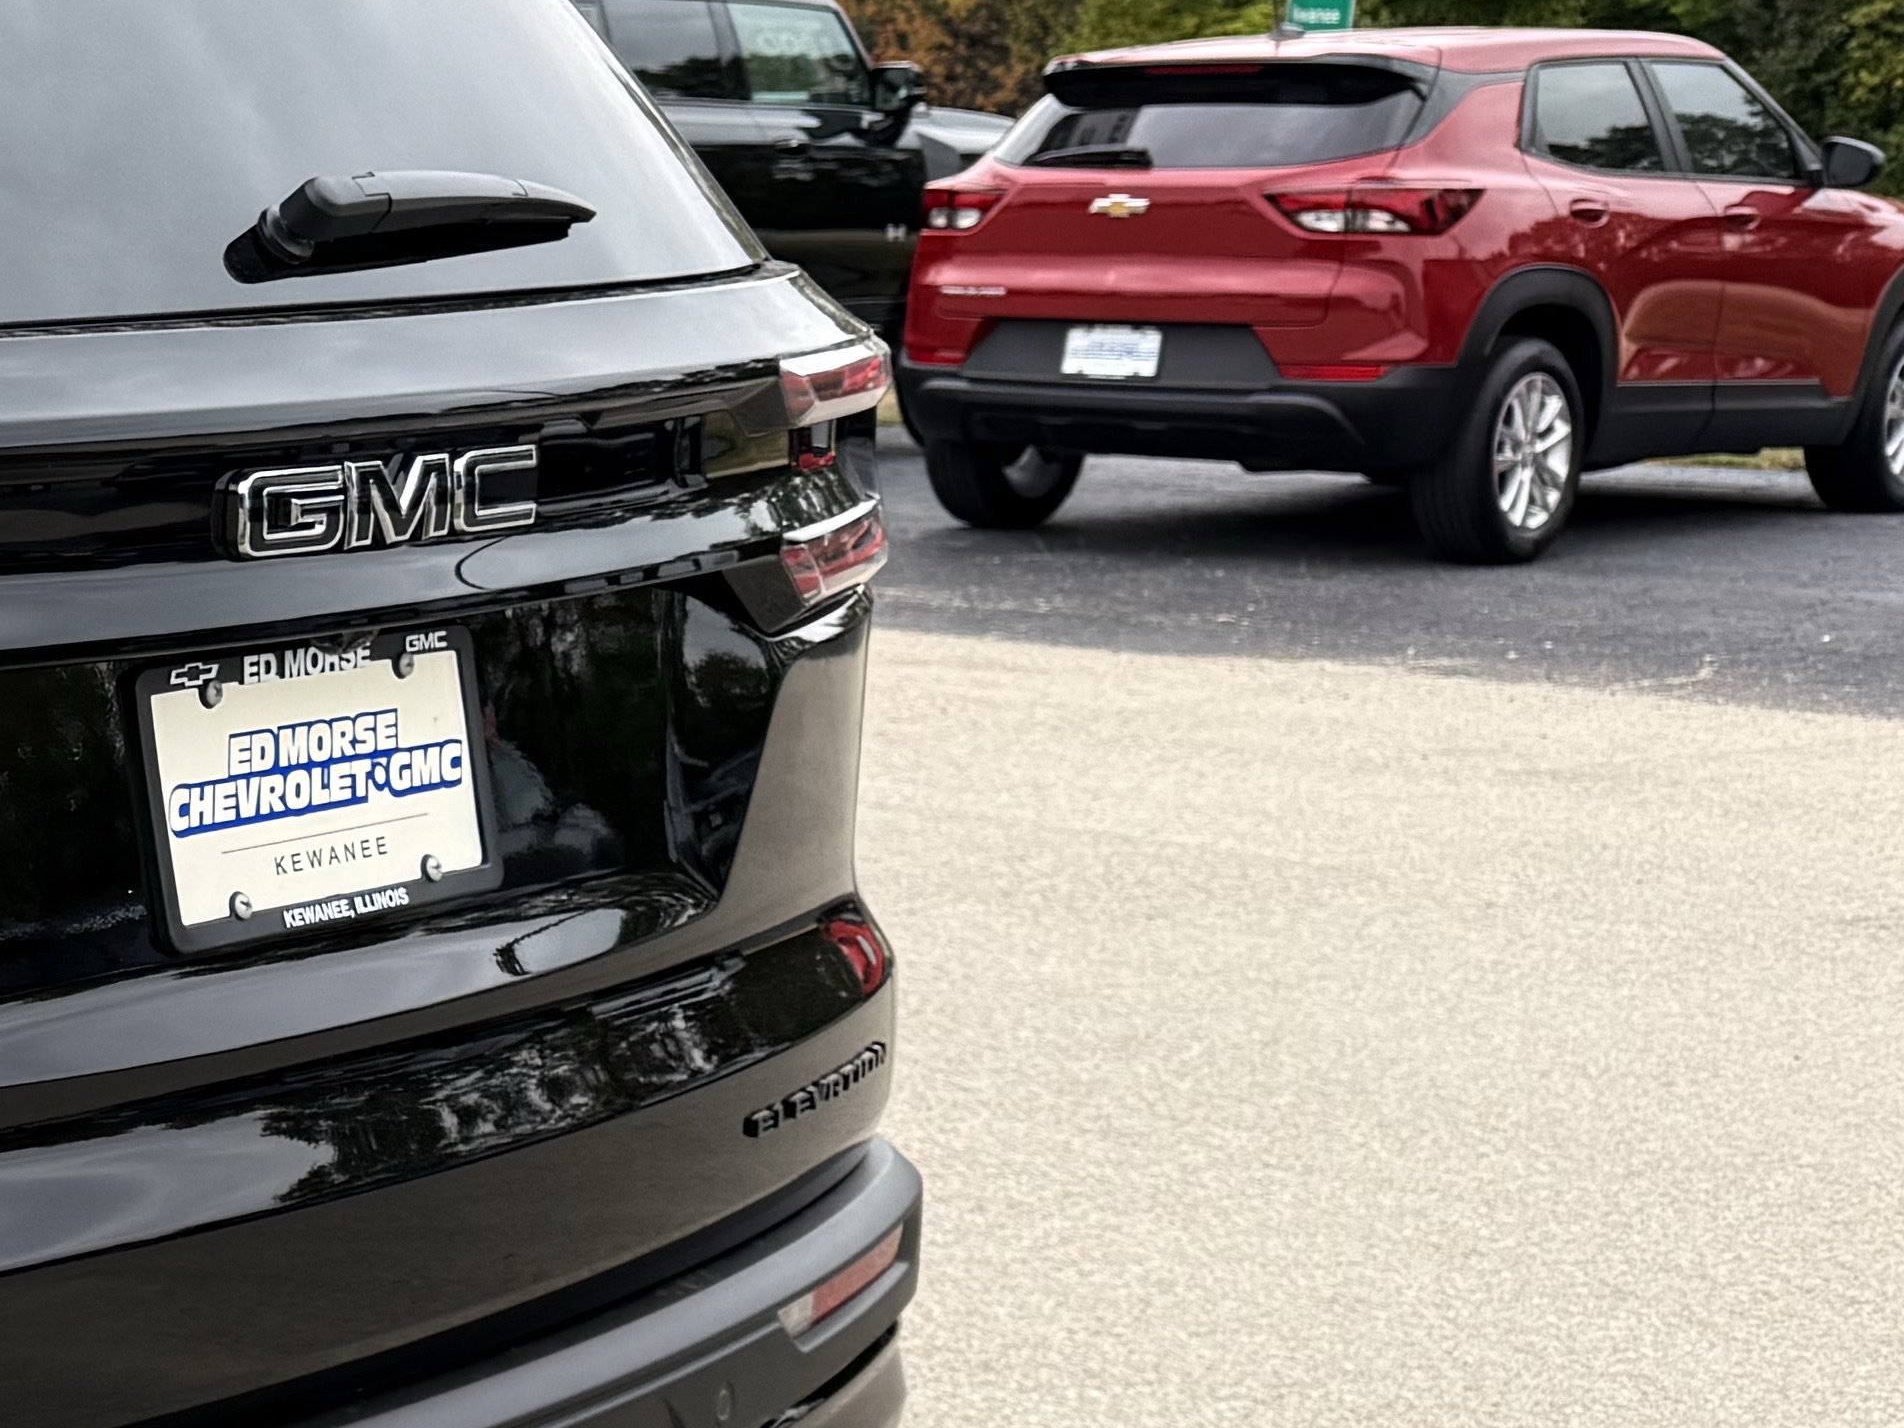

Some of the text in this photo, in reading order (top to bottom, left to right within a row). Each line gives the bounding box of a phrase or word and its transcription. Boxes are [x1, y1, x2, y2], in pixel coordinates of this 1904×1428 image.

[234, 444, 538, 558] GMC
[404, 630, 448, 653] GMC
[242, 651, 280, 685] ED
[229, 711, 398, 776] ED MORSE
[273, 836, 388, 876] KEWANEE
[282, 886, 410, 929] KEWANEE, ILLINOIS
